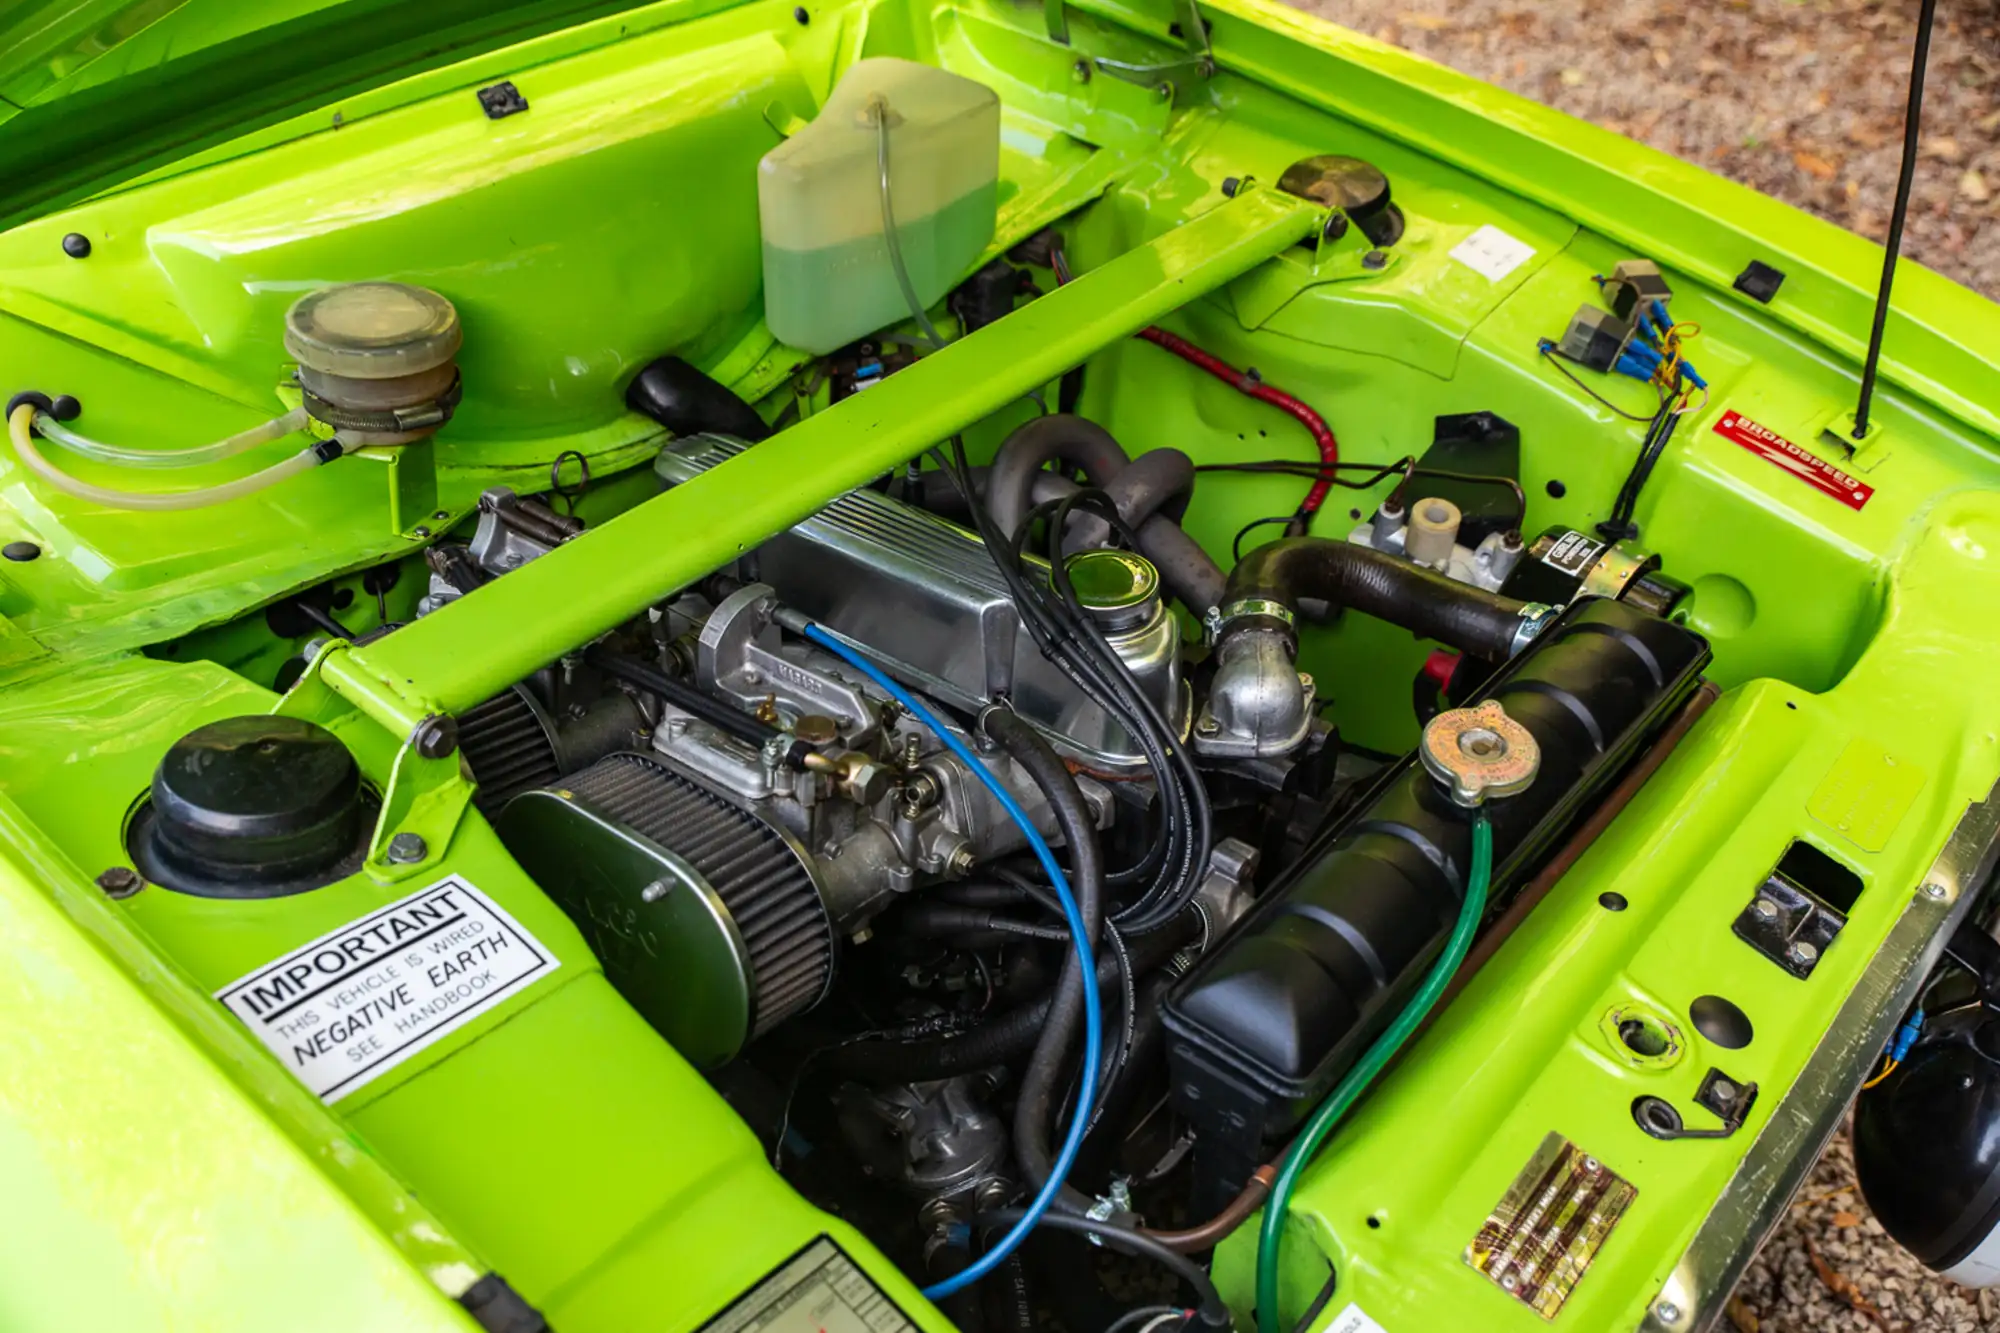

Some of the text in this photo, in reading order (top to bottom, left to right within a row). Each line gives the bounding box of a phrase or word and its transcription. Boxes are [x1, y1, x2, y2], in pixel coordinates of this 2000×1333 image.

[1735, 416, 1860, 489] BROADSPEED
[241, 890, 463, 1015] IMPORTANT
[276, 920, 484, 1039] THIS VEHICLE IS WIRED
[292, 930, 509, 1067] NEGATIVE EARTH
[346, 968, 498, 1063] SEE HANDBOOK
